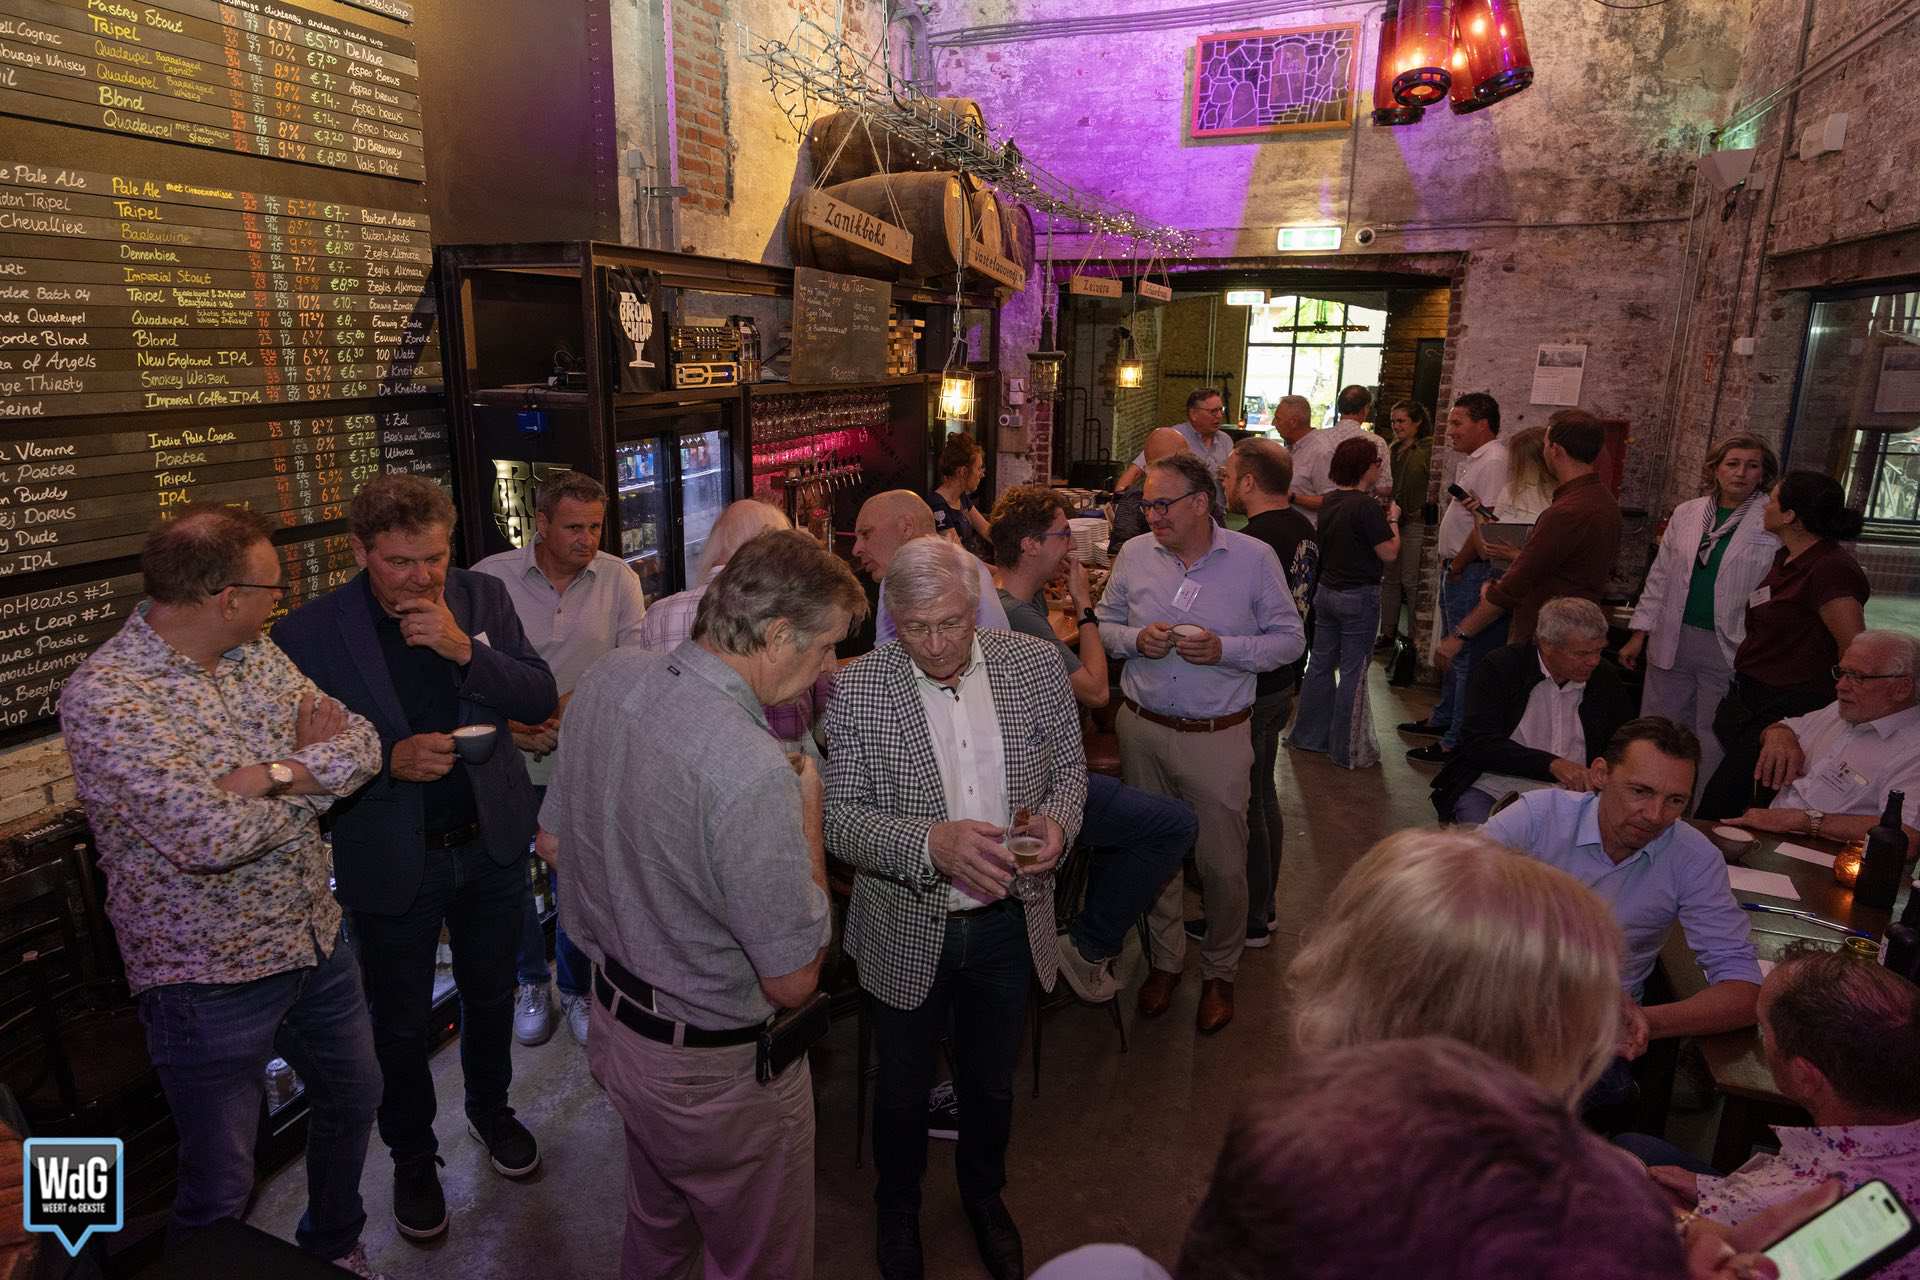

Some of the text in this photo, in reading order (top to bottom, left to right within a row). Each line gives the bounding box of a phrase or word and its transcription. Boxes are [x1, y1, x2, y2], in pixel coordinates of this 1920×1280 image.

[88, 14, 141, 41] Tripel
[143, 9, 184, 33] Stout
[17, 22, 62, 44] Cognac
[95, 40, 153, 65] Quadrupel
[268, 40, 296, 62] 10%
[45, 53, 87, 76] Whisky
[346, 62, 373, 78] Aspro
[97, 63, 160, 90] Quadrupel
[349, 80, 372, 97] Aspro
[99, 86, 145, 111] Blond
[351, 99, 376, 117] Aspro
[103, 109, 172, 137] Quadrupel
[352, 117, 379, 136] Aspro
[14, 165, 87, 187] Pale Ale
[112, 176, 139, 196] Pale
[143, 179, 161, 198] Ale
[25, 192, 72, 212] Tripel
[114, 201, 162, 220] Tripel
[0, 212, 87, 234] Chevallier
[120, 245, 180, 263] Dennenbier
[124, 267, 213, 285] Imperial Stout
[75, 288, 91, 302] 04
[127, 288, 166, 304] Tripel
[27, 307, 86, 325] Quadrupel
[131, 310, 190, 327] Quadrupel
[400, 314, 423, 328] Zonde
[41, 331, 90, 347] Blond
[132, 330, 179, 347] Blond
[405, 330, 432, 344] Zonde
[23, 353, 41, 372] of
[45, 351, 97, 371] Angels
[137, 351, 254, 369] New England IPA
[375, 349, 417, 361] 100 Watt
[141, 368, 229, 389] Smokey Weizen
[375, 365, 388, 378] De
[25, 373, 83, 393] Thirsty
[378, 383, 391, 396] De
[144, 389, 263, 409] Imperial Coffee IPA
[148, 427, 237, 450] India Pale Lager
[15, 442, 77, 461] Vlemme
[155, 451, 207, 468] Porter
[18, 464, 77, 482] Porter
[155, 471, 197, 488] Tripel
[14, 486, 68, 503] Buddy
[158, 489, 192, 506] IPA
[24, 506, 77, 524] Dorus
[15, 529, 59, 546] Dude
[18, 551, 59, 571] IPA
[35, 616, 77, 633] Leap
[81, 603, 117, 621] #1
[36, 634, 89, 655] Passie
